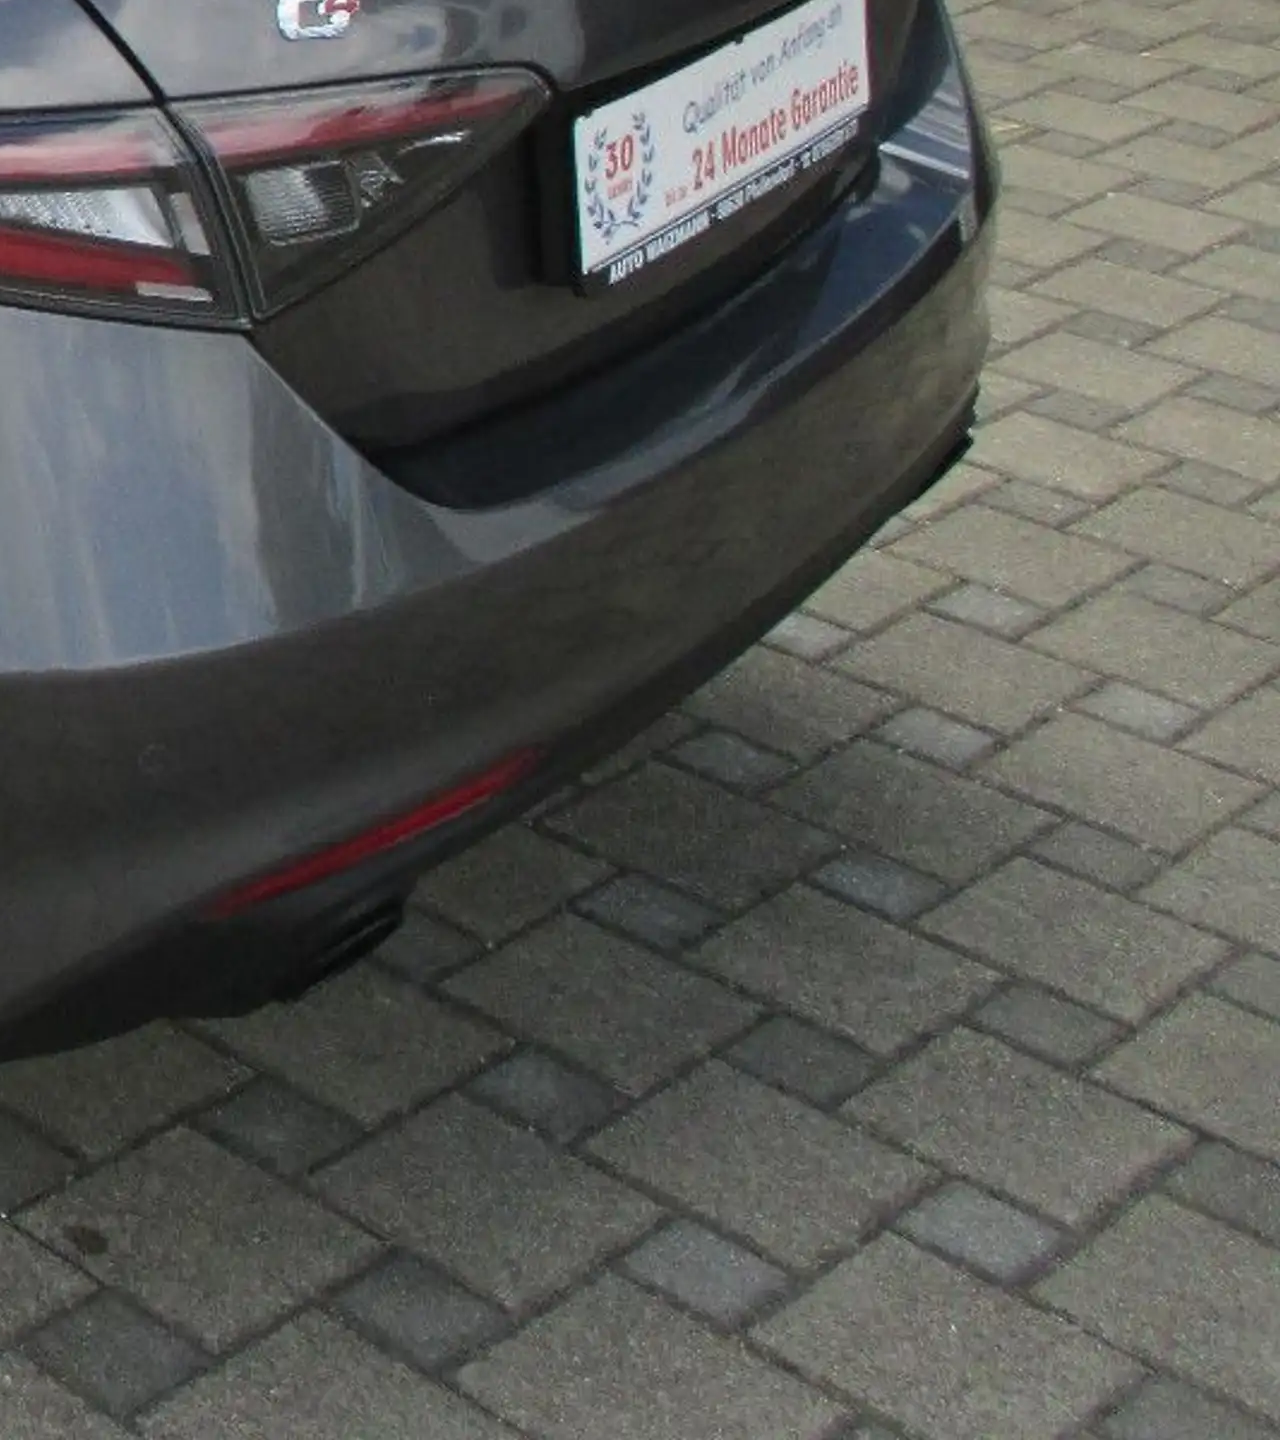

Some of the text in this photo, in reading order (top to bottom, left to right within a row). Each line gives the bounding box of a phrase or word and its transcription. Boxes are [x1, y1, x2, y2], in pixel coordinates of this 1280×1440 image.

[605, 134, 634, 179] 30
[692, 140, 715, 191] 24
[721, 106, 787, 174] Monate
[791, 59, 859, 132] Garantie
